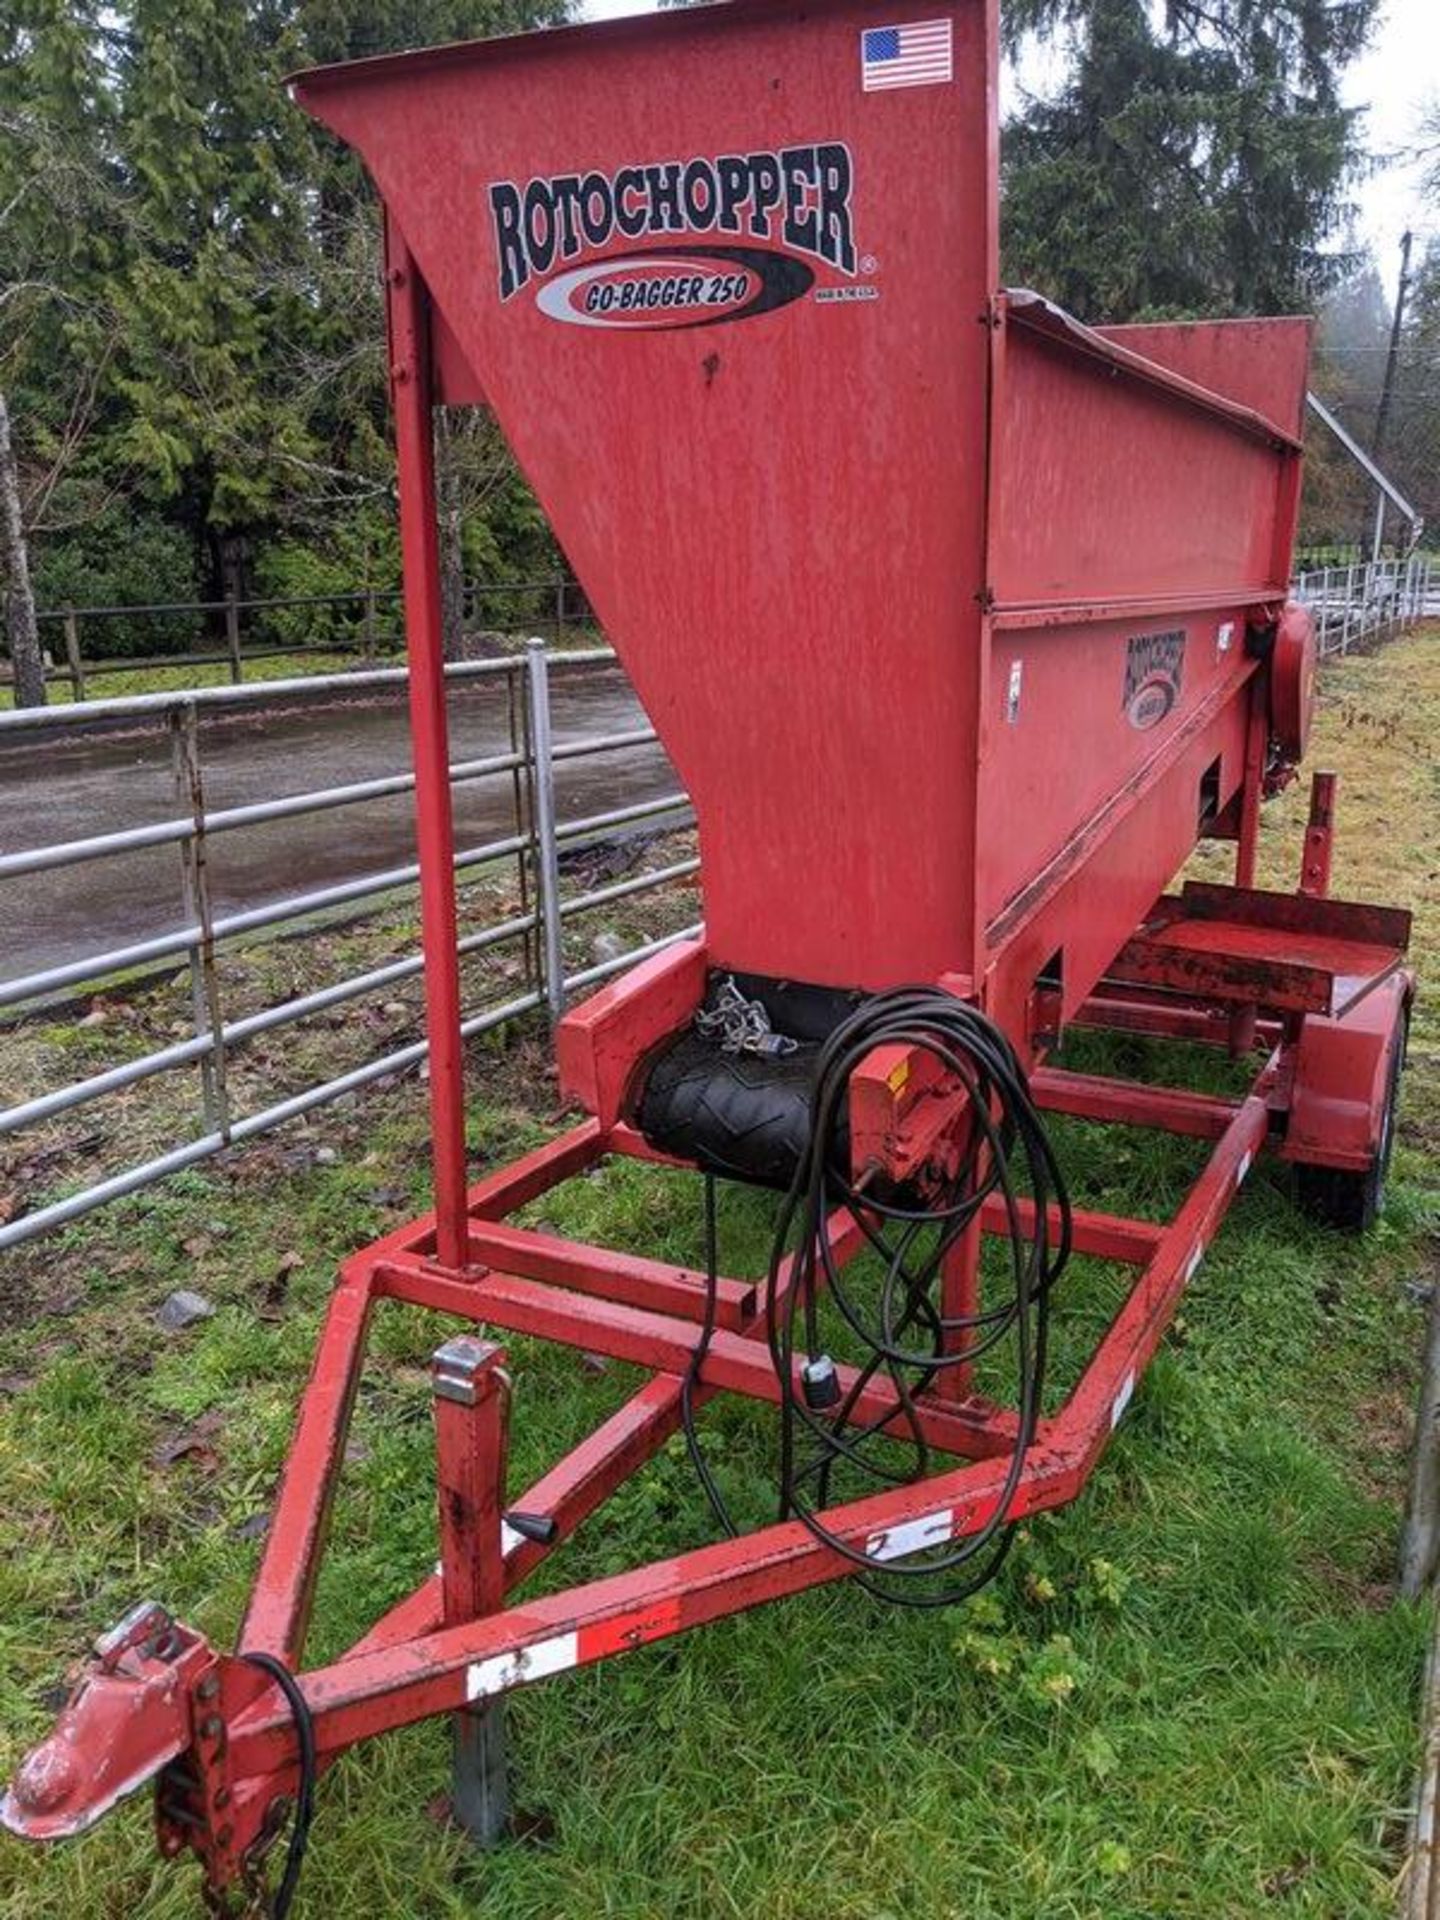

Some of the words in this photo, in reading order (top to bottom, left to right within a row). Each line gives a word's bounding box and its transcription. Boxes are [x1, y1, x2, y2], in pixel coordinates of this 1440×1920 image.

[488, 143, 856, 301] ROTOCHOPPER
[585, 278, 704, 312] GO-BAGGER
[706, 274, 749, 303] 250
